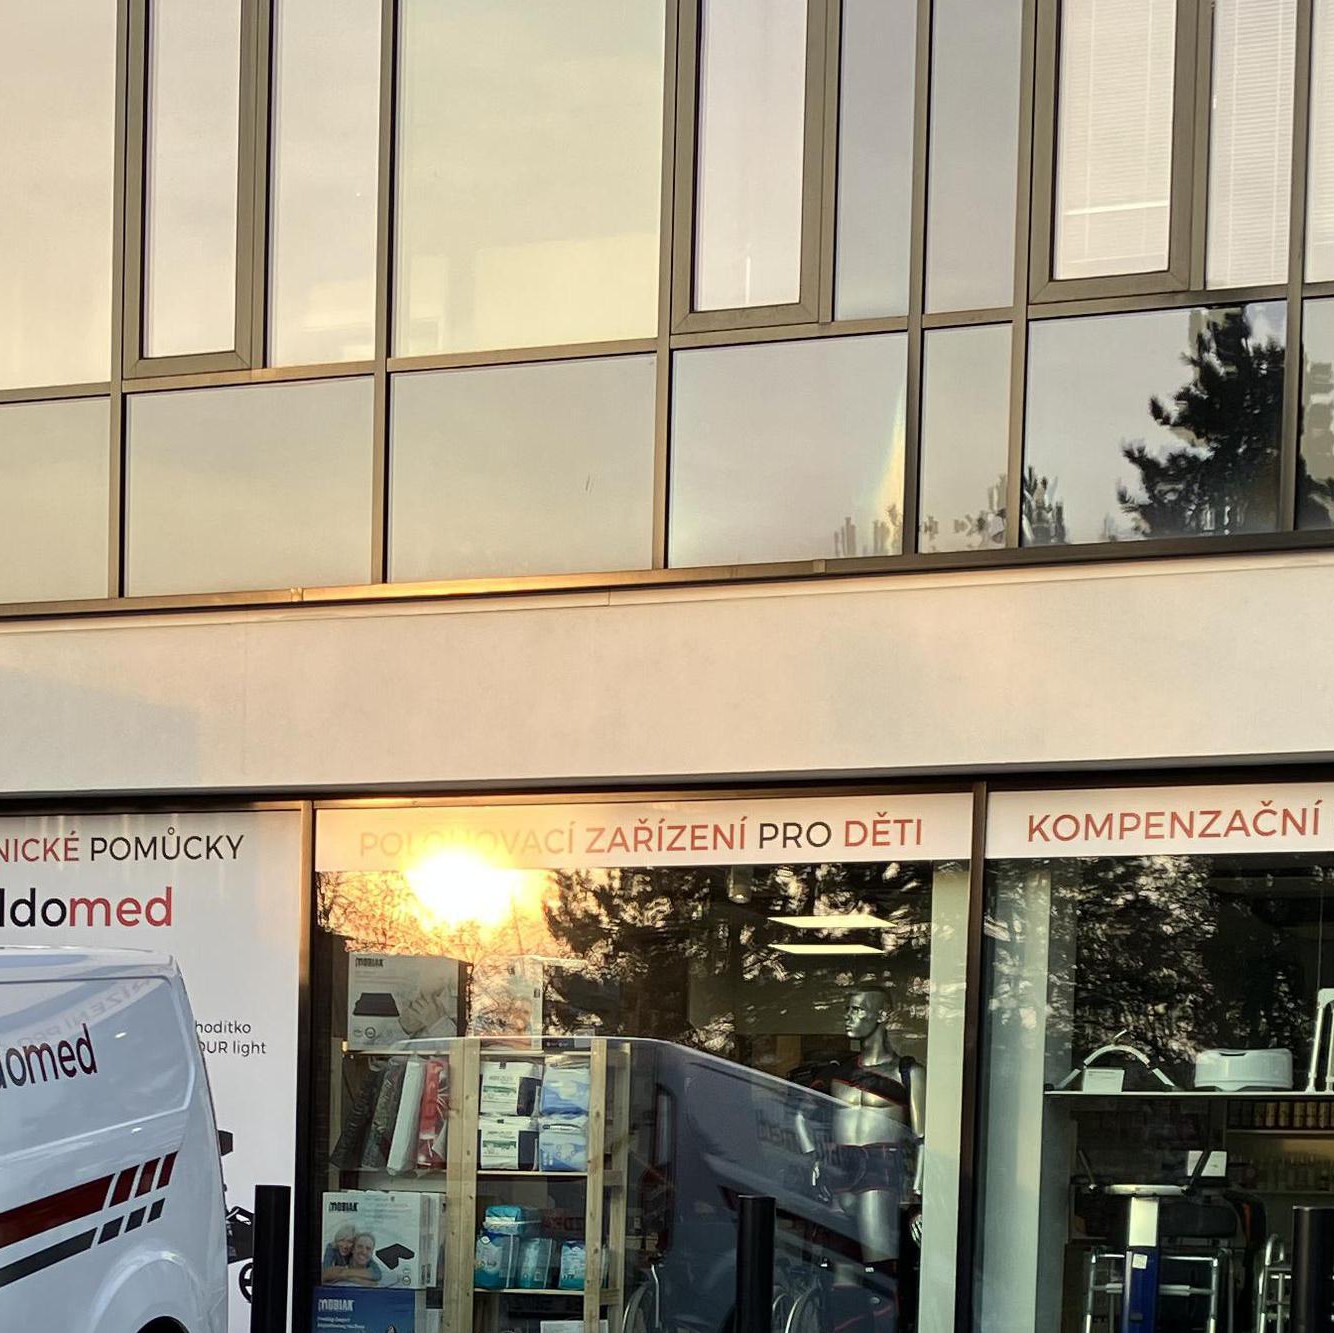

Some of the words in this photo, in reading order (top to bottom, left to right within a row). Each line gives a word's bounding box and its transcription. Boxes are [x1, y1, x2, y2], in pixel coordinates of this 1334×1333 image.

[360, 821, 576, 858] POLOVACÍ
[584, 815, 746, 854] ZAŘÍZENÍ
[758, 820, 833, 849] PRO
[843, 811, 923, 848] DĚTI
[1027, 799, 1323, 843] KOMPENZAČNÍ
[90, 826, 245, 862] POMŮCKY
[233, 1040, 267, 1057] light
